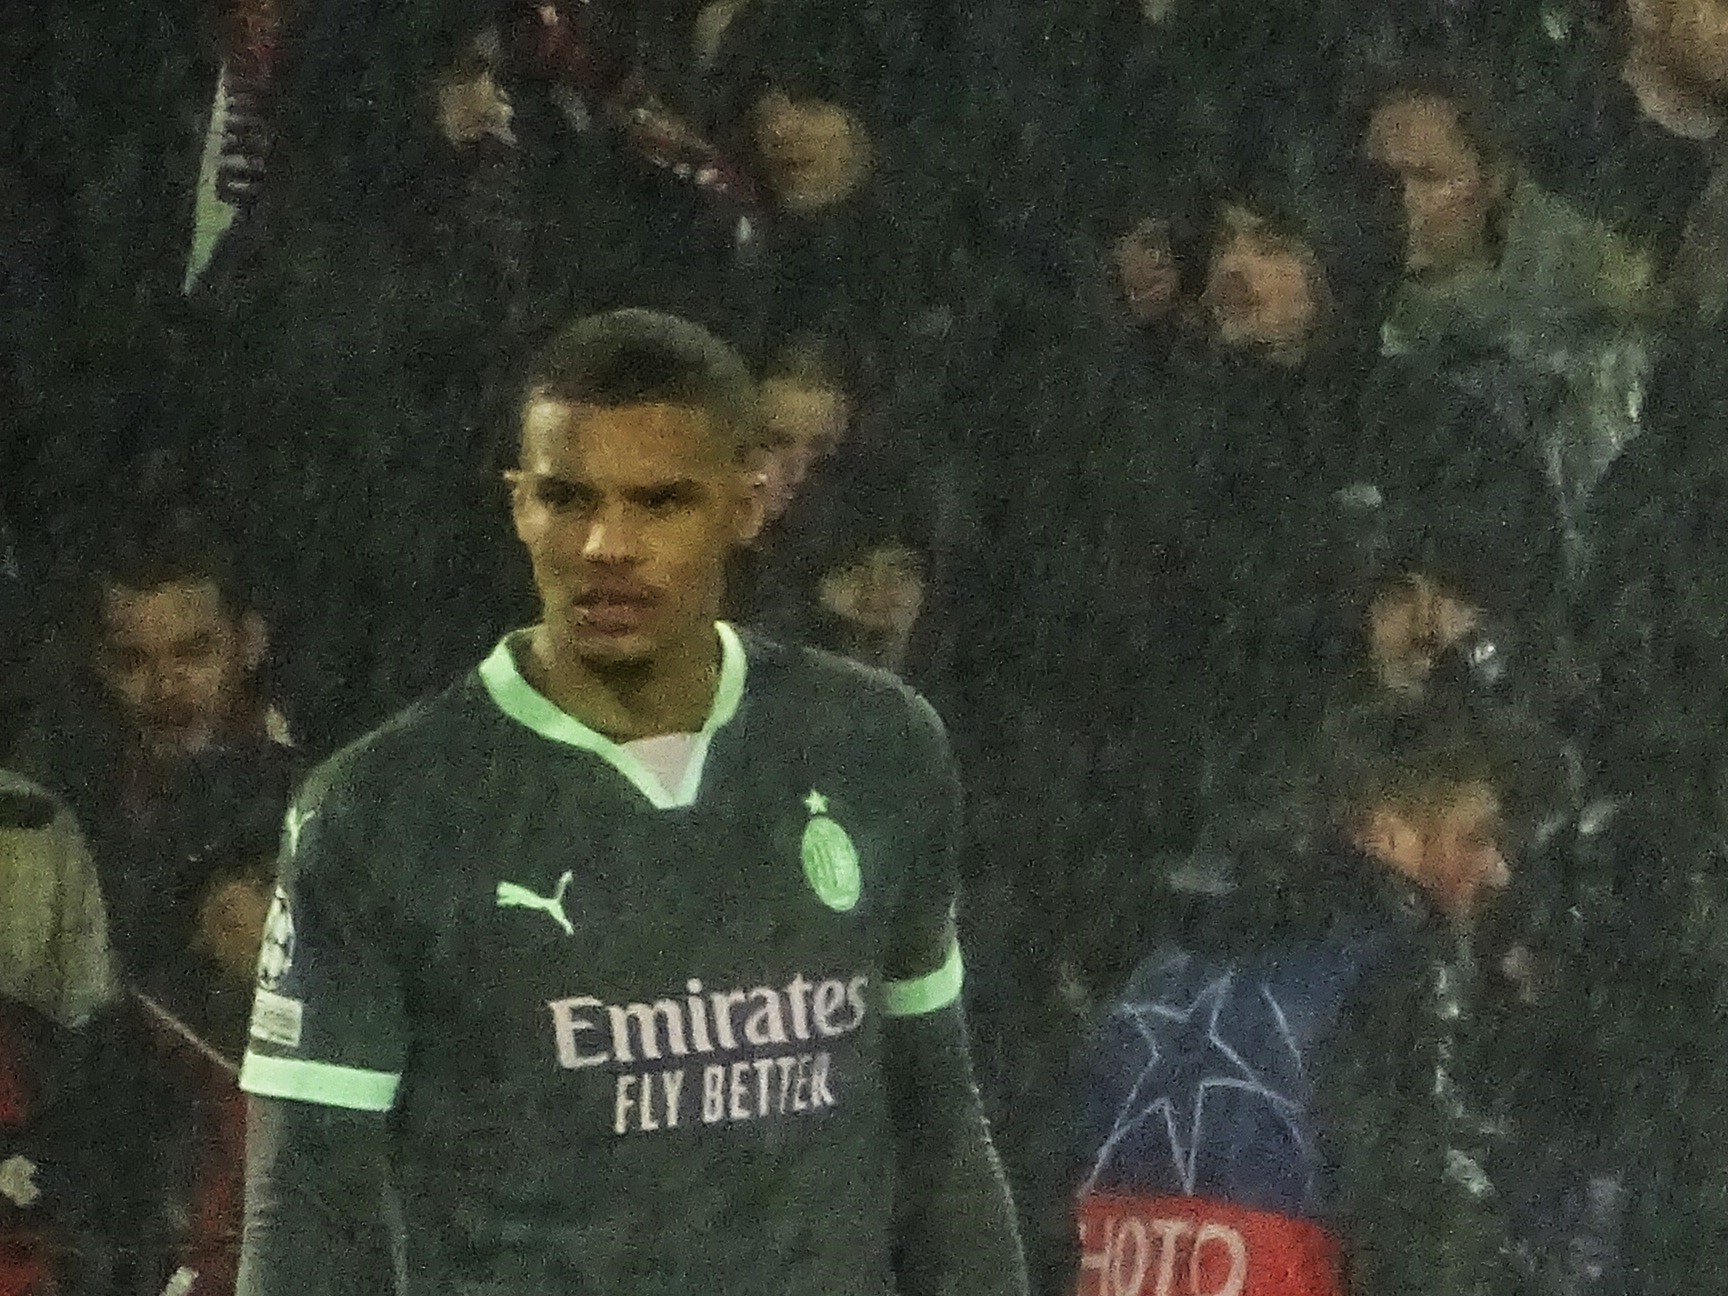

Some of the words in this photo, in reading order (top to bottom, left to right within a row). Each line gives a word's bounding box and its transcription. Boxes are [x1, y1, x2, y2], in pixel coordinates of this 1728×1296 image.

[549, 973, 869, 1069] Emirates
[614, 1070, 685, 1134] FLY
[703, 1052, 835, 1124] BETTER
